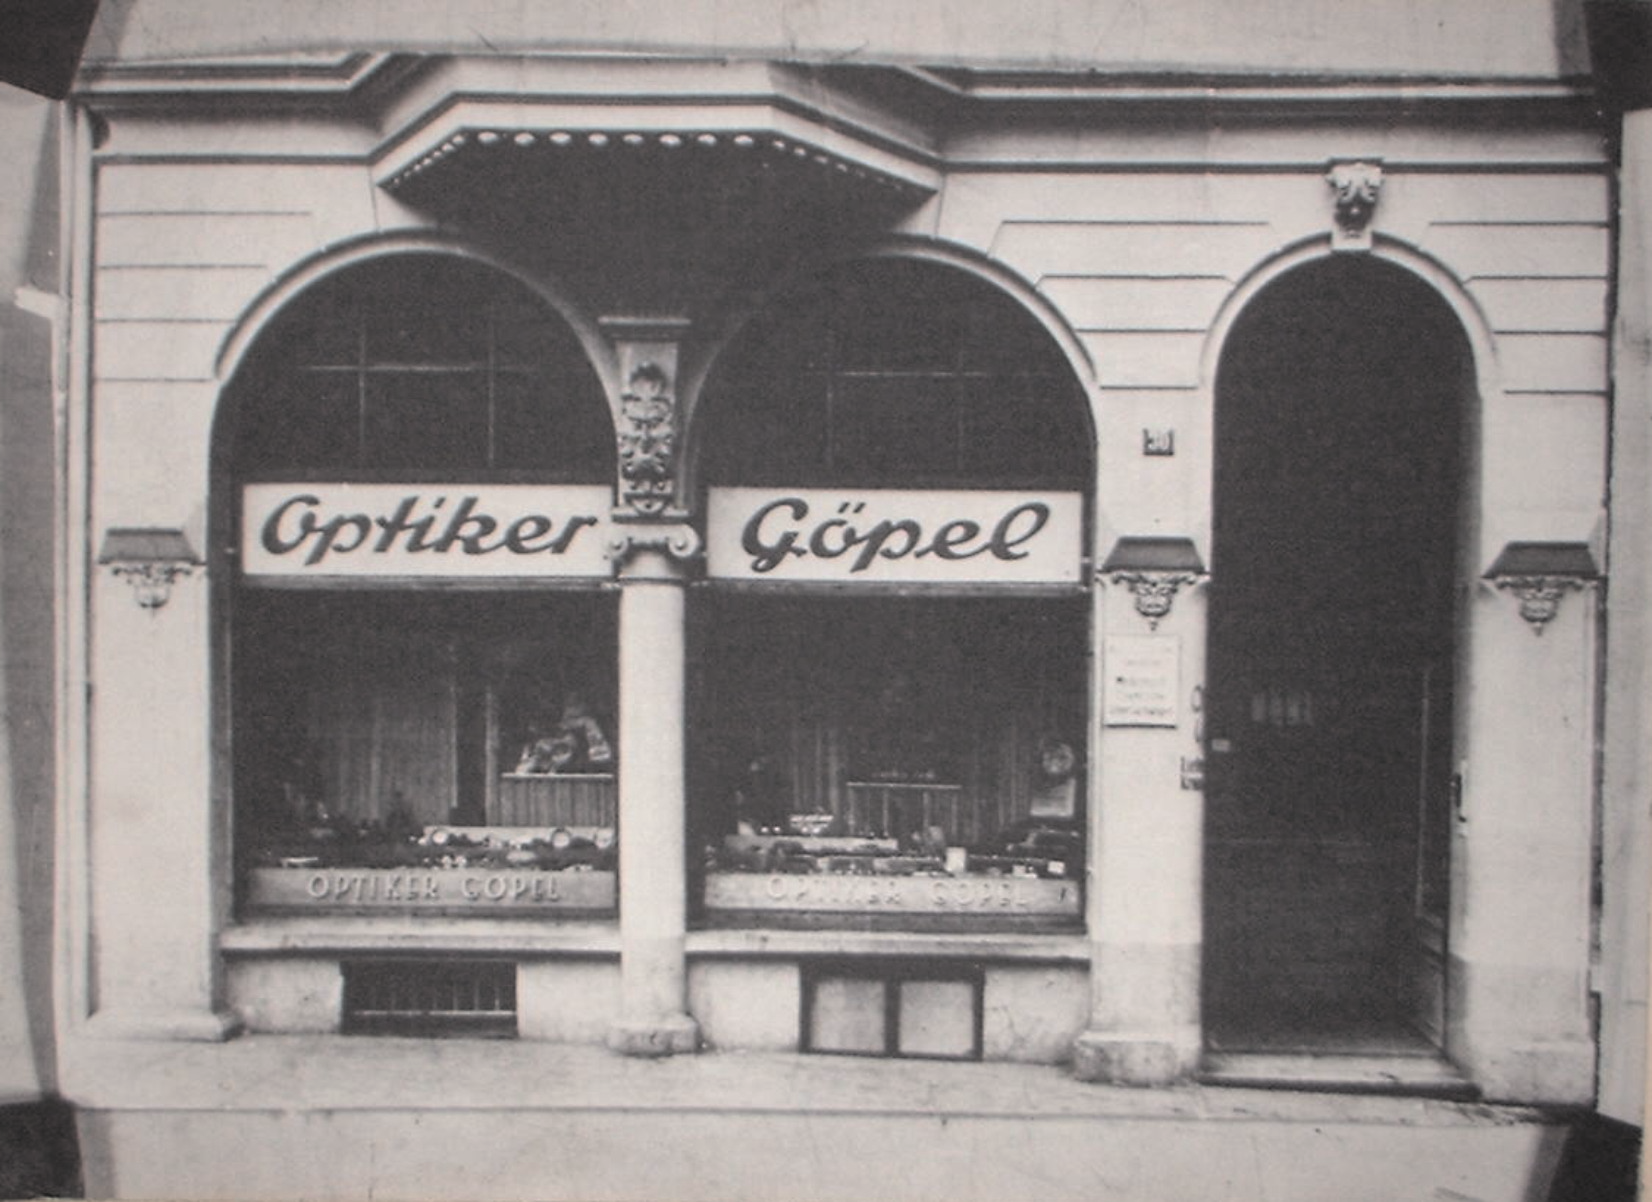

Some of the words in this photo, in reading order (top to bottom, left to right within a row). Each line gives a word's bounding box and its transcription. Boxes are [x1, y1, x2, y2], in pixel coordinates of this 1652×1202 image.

[261, 495, 598, 566] Optiker
[741, 497, 1050, 573] Göpel
[307, 873, 441, 901] OPTIKER
